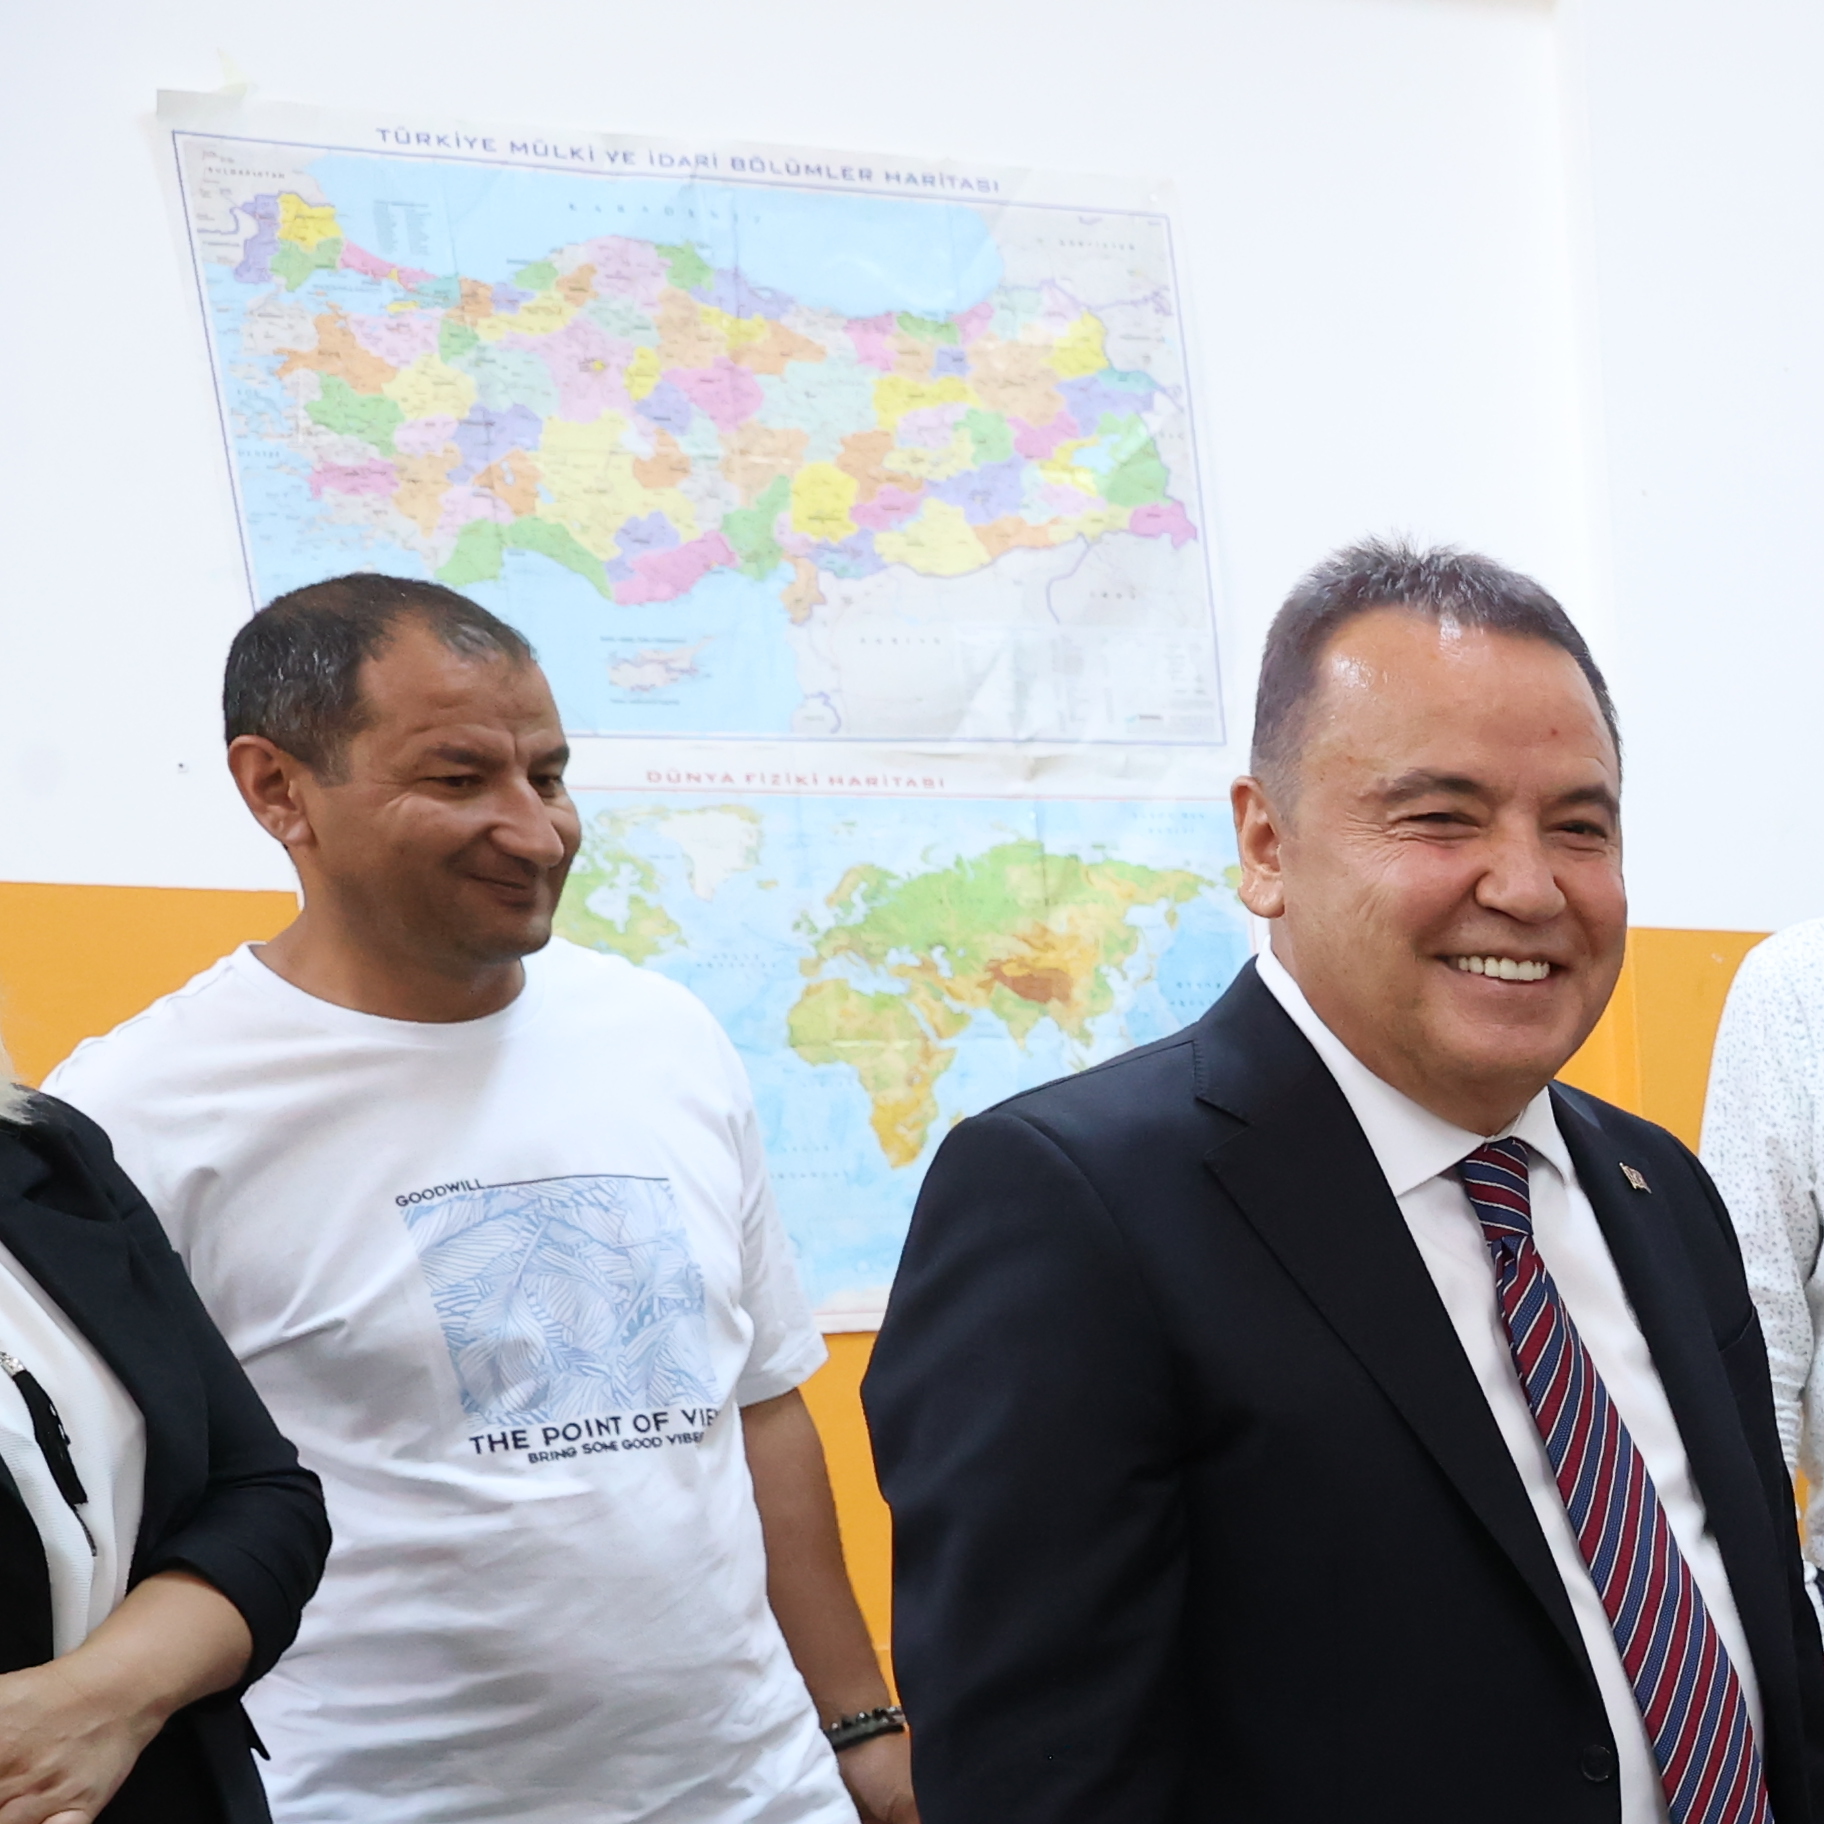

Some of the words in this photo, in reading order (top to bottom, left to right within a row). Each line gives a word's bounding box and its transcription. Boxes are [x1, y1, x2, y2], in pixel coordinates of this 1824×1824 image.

[375, 126, 497, 152] TÜRKİYE
[509, 138, 595, 163] MÜLKİ
[605, 149, 635, 164] VE
[648, 149, 718, 169] İDARİ
[731, 154, 873, 182] BÖLÜMLER
[885, 169, 999, 193] HARİTASI
[395, 1179, 485, 1208] GOODWILL
[469, 1429, 531, 1455] THE
[542, 1416, 622, 1446] POINT
[632, 1411, 669, 1434] OF
[527, 1446, 578, 1465] BRING
[582, 1440, 619, 1455] SOME
[622, 1436, 663, 1451] GOOD
